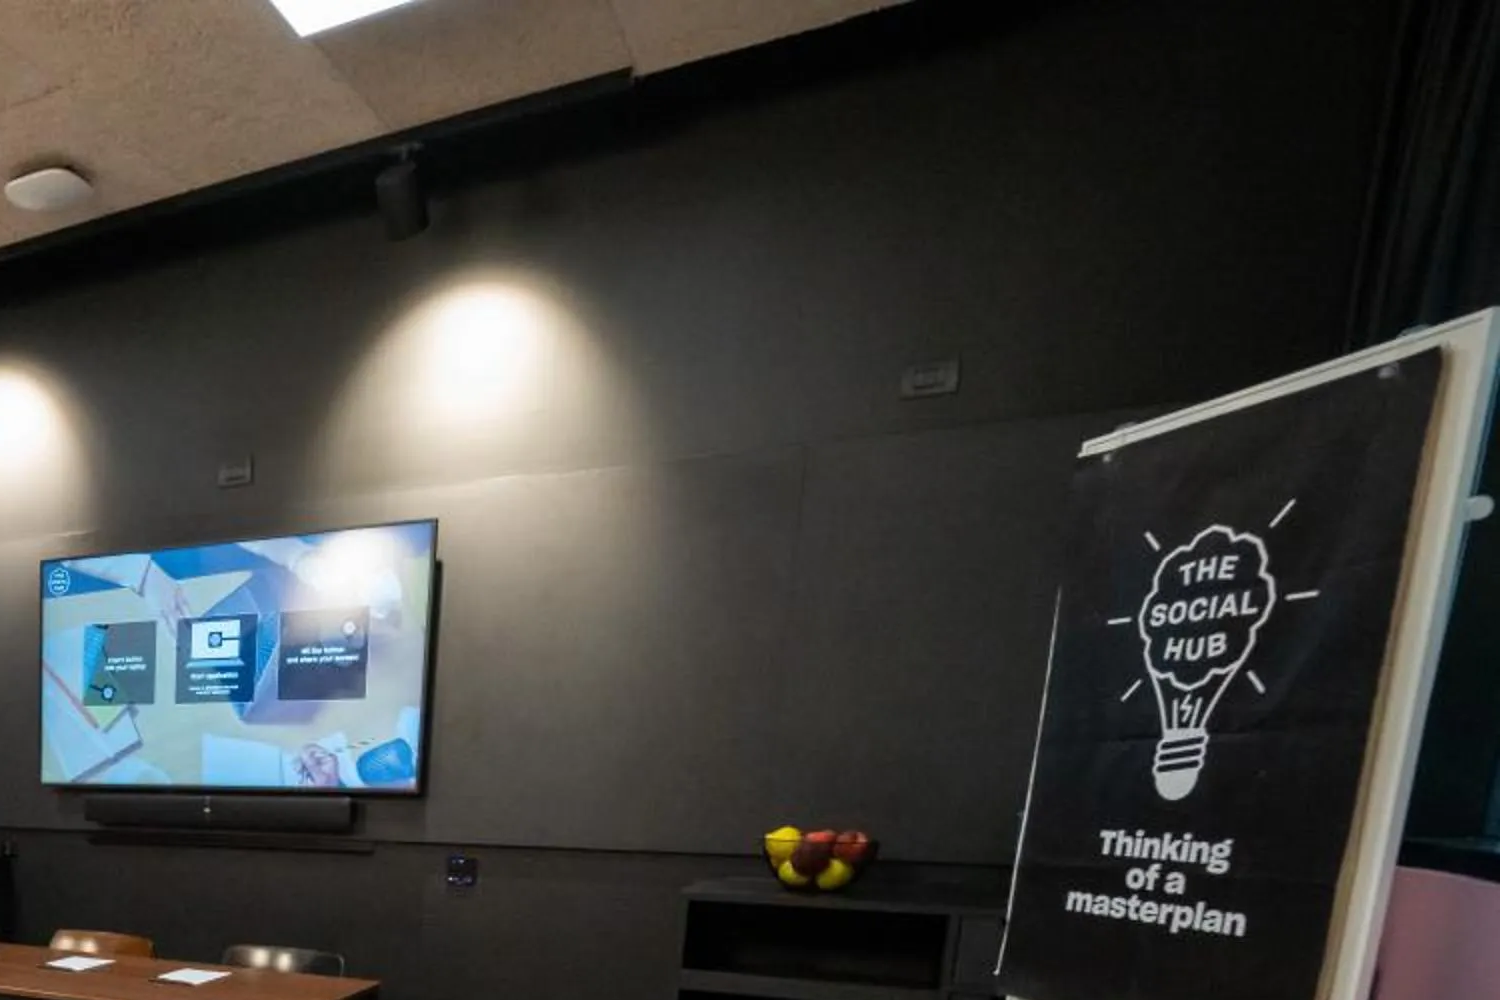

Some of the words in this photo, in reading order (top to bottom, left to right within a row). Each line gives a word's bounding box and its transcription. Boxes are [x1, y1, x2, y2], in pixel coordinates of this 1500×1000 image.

[1179, 555, 1240, 586] THE
[1150, 590, 1259, 627] SOCIAL
[1164, 632, 1227, 661] HUB
[1100, 829, 1235, 875] Thinking
[1125, 863, 1162, 891] of
[1163, 871, 1186, 895] a
[1065, 891, 1247, 937] masterplan
